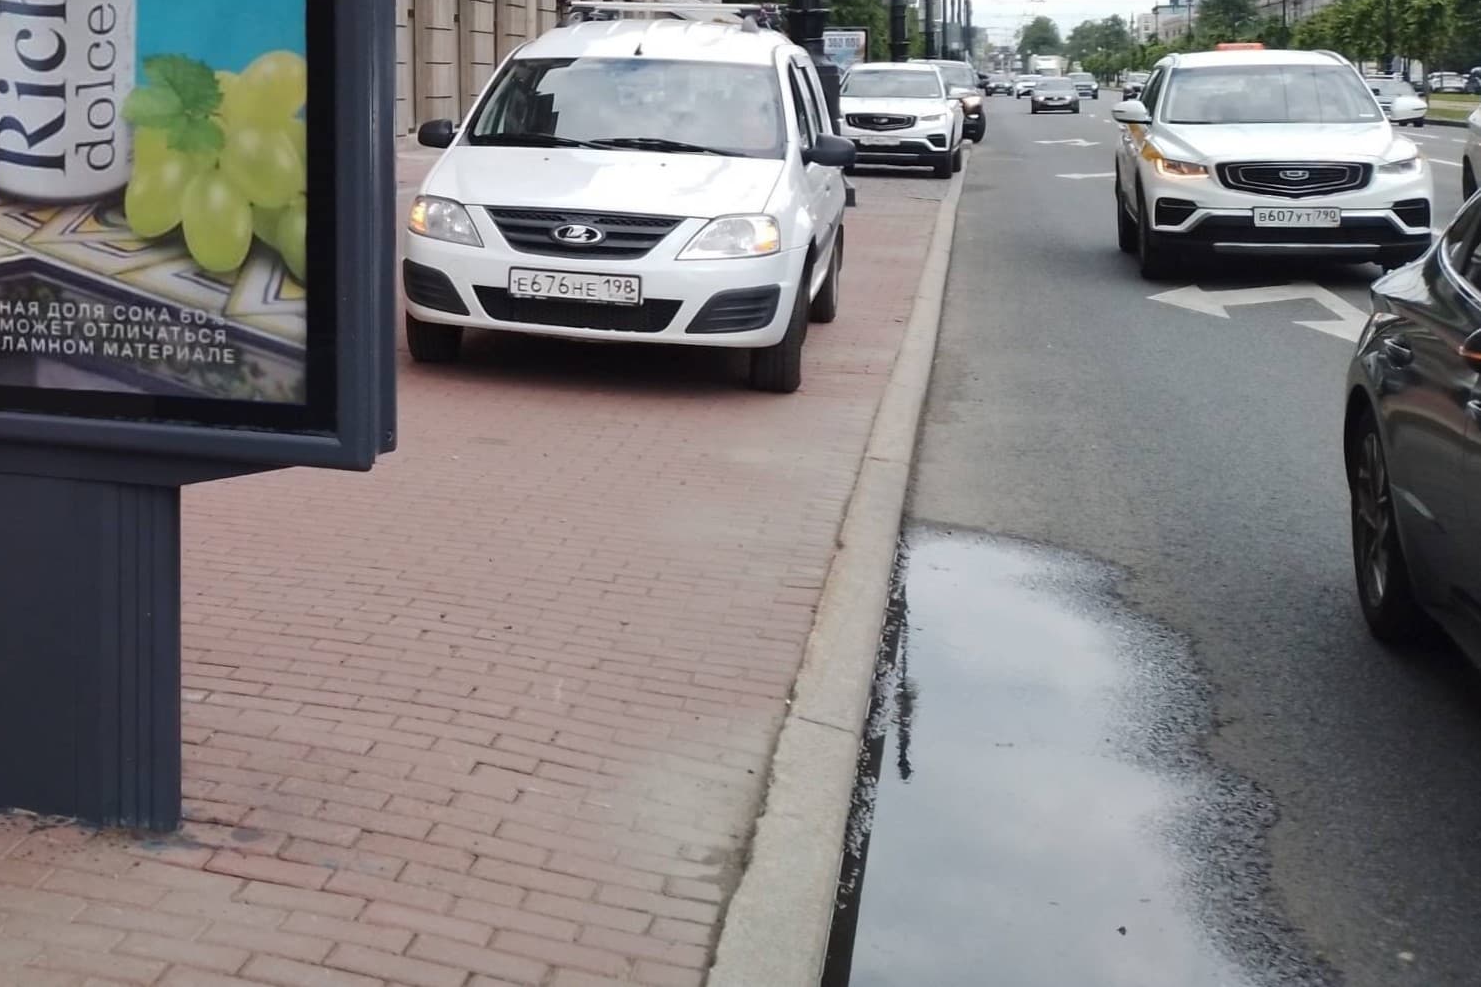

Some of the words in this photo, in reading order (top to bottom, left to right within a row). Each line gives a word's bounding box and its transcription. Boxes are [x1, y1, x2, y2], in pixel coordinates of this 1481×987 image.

[75, 2, 117, 172] dolce
[603, 279, 633, 294] 198
[47, 301, 105, 320] ДОЛЯ
[113, 305, 172, 322] СОКА
[0, 318, 76, 335] МОЖЕТ
[83, 322, 228, 344] ОТЛИЧАТЬСЯ
[102, 343, 236, 364] МАТЕРИАЛЕ
